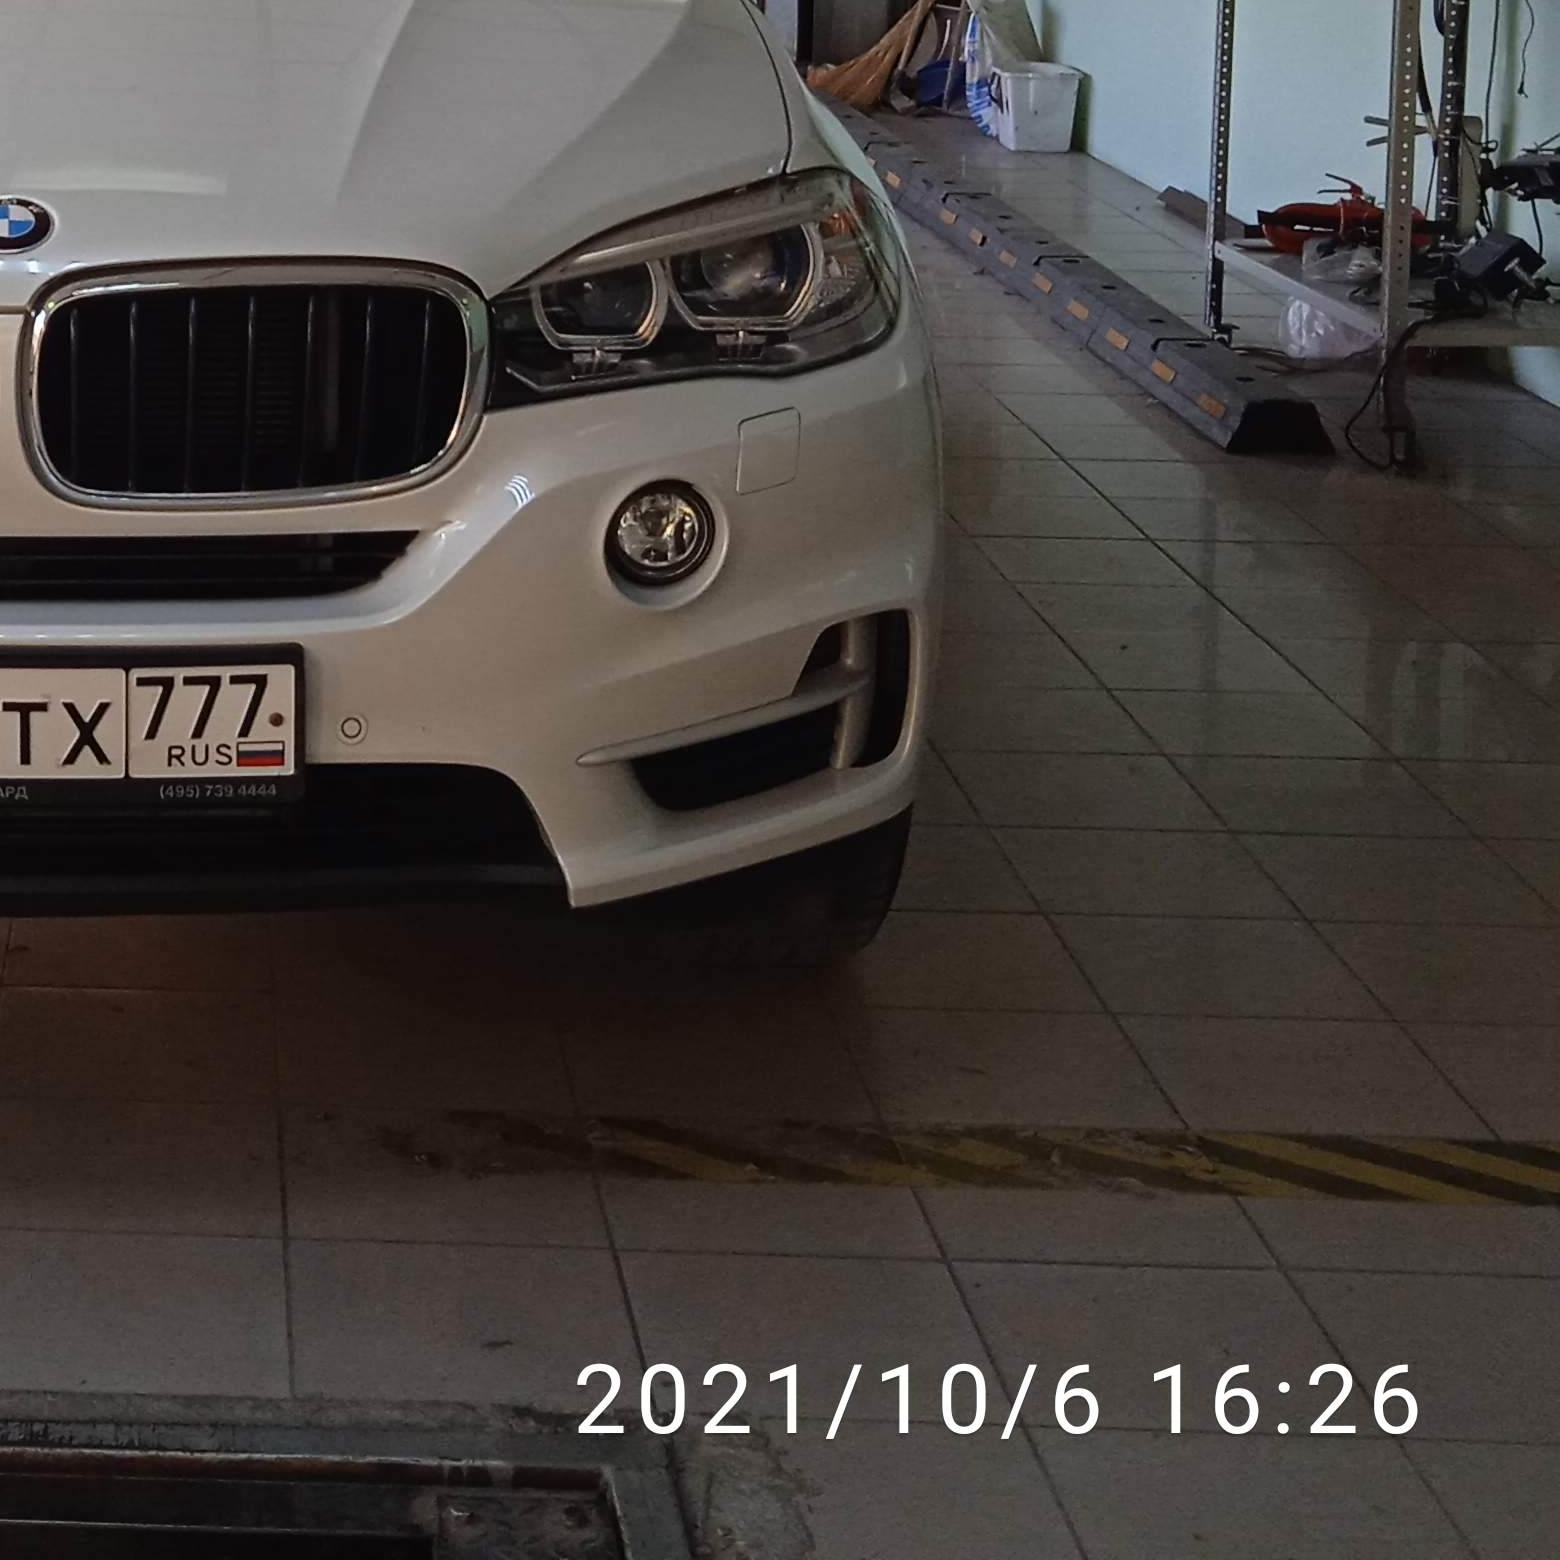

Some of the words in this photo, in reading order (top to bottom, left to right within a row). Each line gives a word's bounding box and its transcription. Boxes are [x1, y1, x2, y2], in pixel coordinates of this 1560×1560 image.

[136, 674, 268, 740] 777
[167, 744, 233, 768] RUS
[160, 784, 200, 799] (495)
[205, 784, 234, 797] 739
[238, 783, 277, 796] 4444
